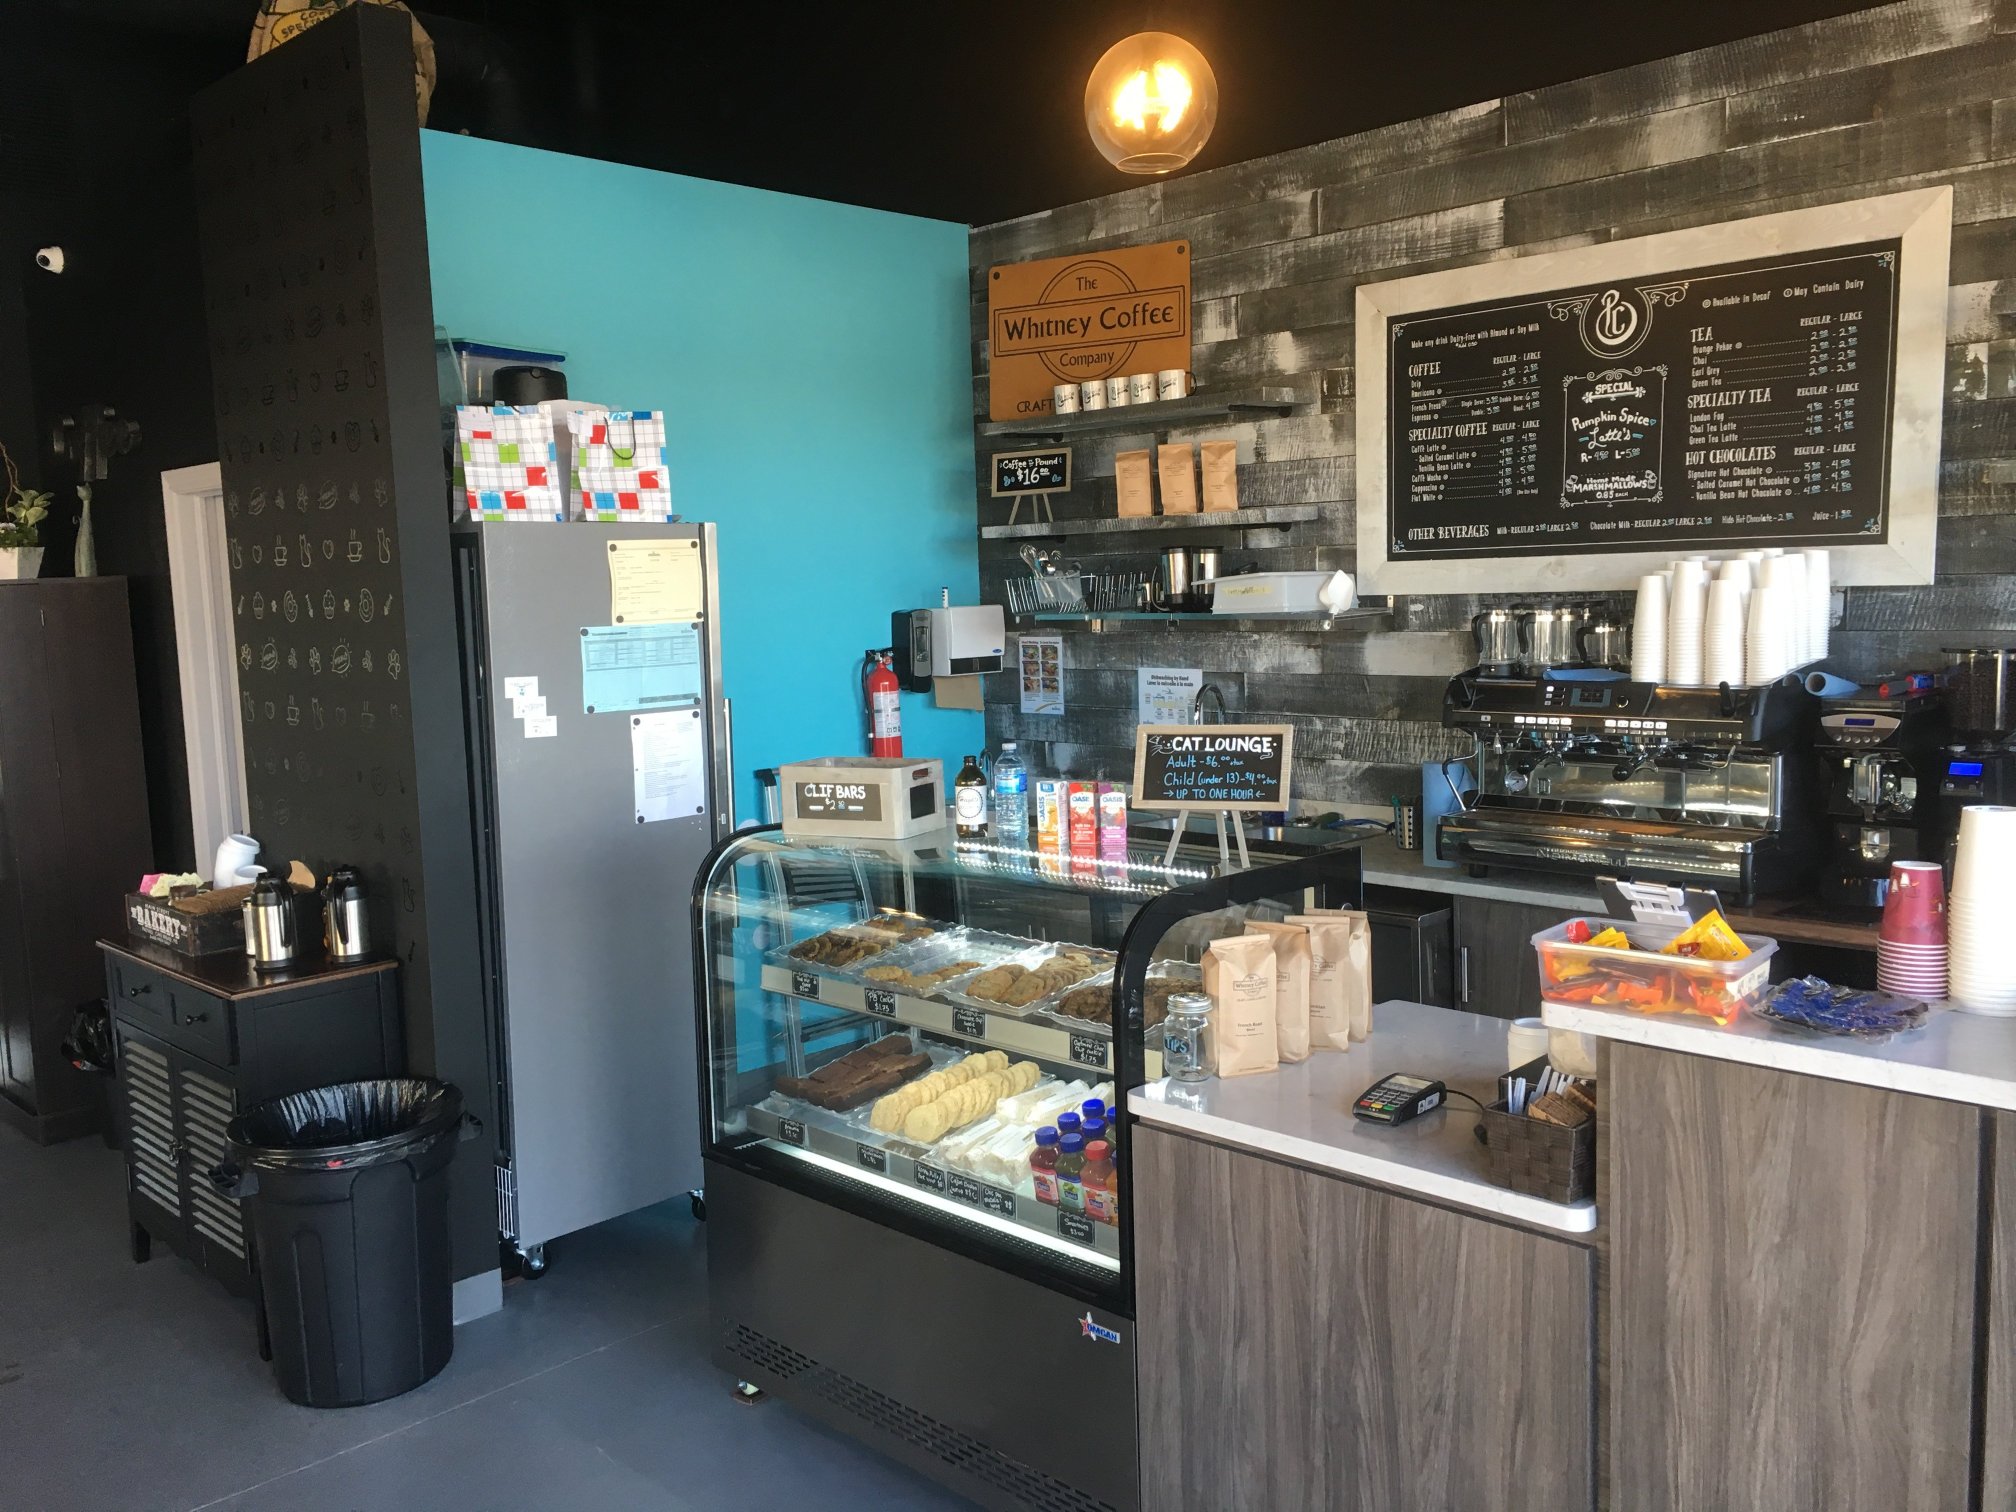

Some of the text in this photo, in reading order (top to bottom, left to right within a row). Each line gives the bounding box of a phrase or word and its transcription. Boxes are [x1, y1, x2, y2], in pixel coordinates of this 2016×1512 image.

[1076, 276, 1099, 291] The
[1794, 279, 1865, 297] May Contain Dairy
[1712, 291, 1771, 307] Available in Decaf
[1004, 302, 1174, 341] Whitney Coffee
[1800, 311, 1863, 327] REGULAR LARGE
[1411, 340, 1423, 349] Make
[1425, 339, 1434, 348] any
[1435, 336, 1448, 346] drink
[1450, 332, 1476, 343] Dairy-Free
[1477, 331, 1489, 340] with
[1490, 328, 1508, 338] Almond
[1517, 325, 1527, 334] Soy
[1528, 322, 1540, 332] Milk
[1690, 326, 1714, 343] TEA
[1693, 342, 1733, 355] Orange Pekoe
[1059, 351, 1115, 368] Company
[1493, 351, 1541, 365] REGULAR LARGE
[1693, 356, 1708, 366] Chai
[1409, 362, 1441, 378] COFFEE
[1691, 366, 1720, 377] Earl Grey
[1411, 380, 1422, 389] Drip
[1595, 381, 1634, 395] SPECIAL
[1691, 378, 1722, 389] Green Tea
[1411, 389, 1435, 398] Americano
[1687, 383, 1860, 409] SPECIALTY TEA REGULAR LARGE
[1411, 403, 1427, 412] French
[1411, 413, 1431, 423] Espresso
[1572, 407, 1650, 431] Pumpkin Spice
[1689, 411, 1725, 423] London Fog
[1409, 420, 1540, 441] SPECIALTY COFFEE REGULAR LARGE
[1689, 422, 1737, 434] Chai Tea Latte
[1588, 427, 1631, 449] Latte's
[1689, 433, 1739, 446] Green Tea Latte
[1426, 444, 1440, 453] Latte
[1685, 443, 1857, 466] HOT CHOCOLATES REGULAR LARGE
[1003, 459, 1027, 469] Coffee
[1035, 457, 1058, 467] Pound
[1419, 451, 1469, 463] Salted Caramel Latte
[1419, 464, 1435, 472] Vanilla
[1437, 463, 1449, 471] Bean
[1451, 461, 1464, 470] Latte
[1687, 466, 1763, 480] Signature Hot Chocolate
[1426, 473, 1441, 482] Mocha
[1611, 475, 1636, 483] Made
[1697, 476, 1790, 490] Salted Caramel Hot Chocolate
[1411, 484, 1438, 494] Cappuccino
[1573, 480, 1648, 493] MARSHMALLOWS
[1411, 493, 1436, 502] Flat White
[1596, 490, 1614, 499] 0.85
[1696, 490, 1717, 500] Vanilla
[1720, 490, 1735, 499] Bean
[1738, 489, 1749, 498] Hot
[1751, 488, 1782, 498] Chocolate
[1736, 515, 1746, 523] Hot
[1746, 513, 1772, 523] Chocolate
[1812, 511, 1829, 521] Juice
[1510, 525, 1535, 534] REGULAR
[1547, 523, 1565, 532] LARGE
[1590, 517, 1695, 530] Chocolate Milk REGULAR LARGE
[1408, 525, 1489, 540] OTHER BEVERAGES
[1172, 736, 1272, 753] CAT LOUNGE
[1166, 755, 1196, 768] Adult
[1164, 772, 1194, 786] Child
[1198, 772, 1223, 785] (under
[804, 783, 866, 799] CLIF BARS
[1176, 789, 1253, 800] UP TO ONE HOUR
[1038, 796, 1046, 822] OASIS
[136, 905, 180, 940] BAKERY
[868, 992, 878, 1002] PB
[1166, 1036, 1187, 1052] TIPS
